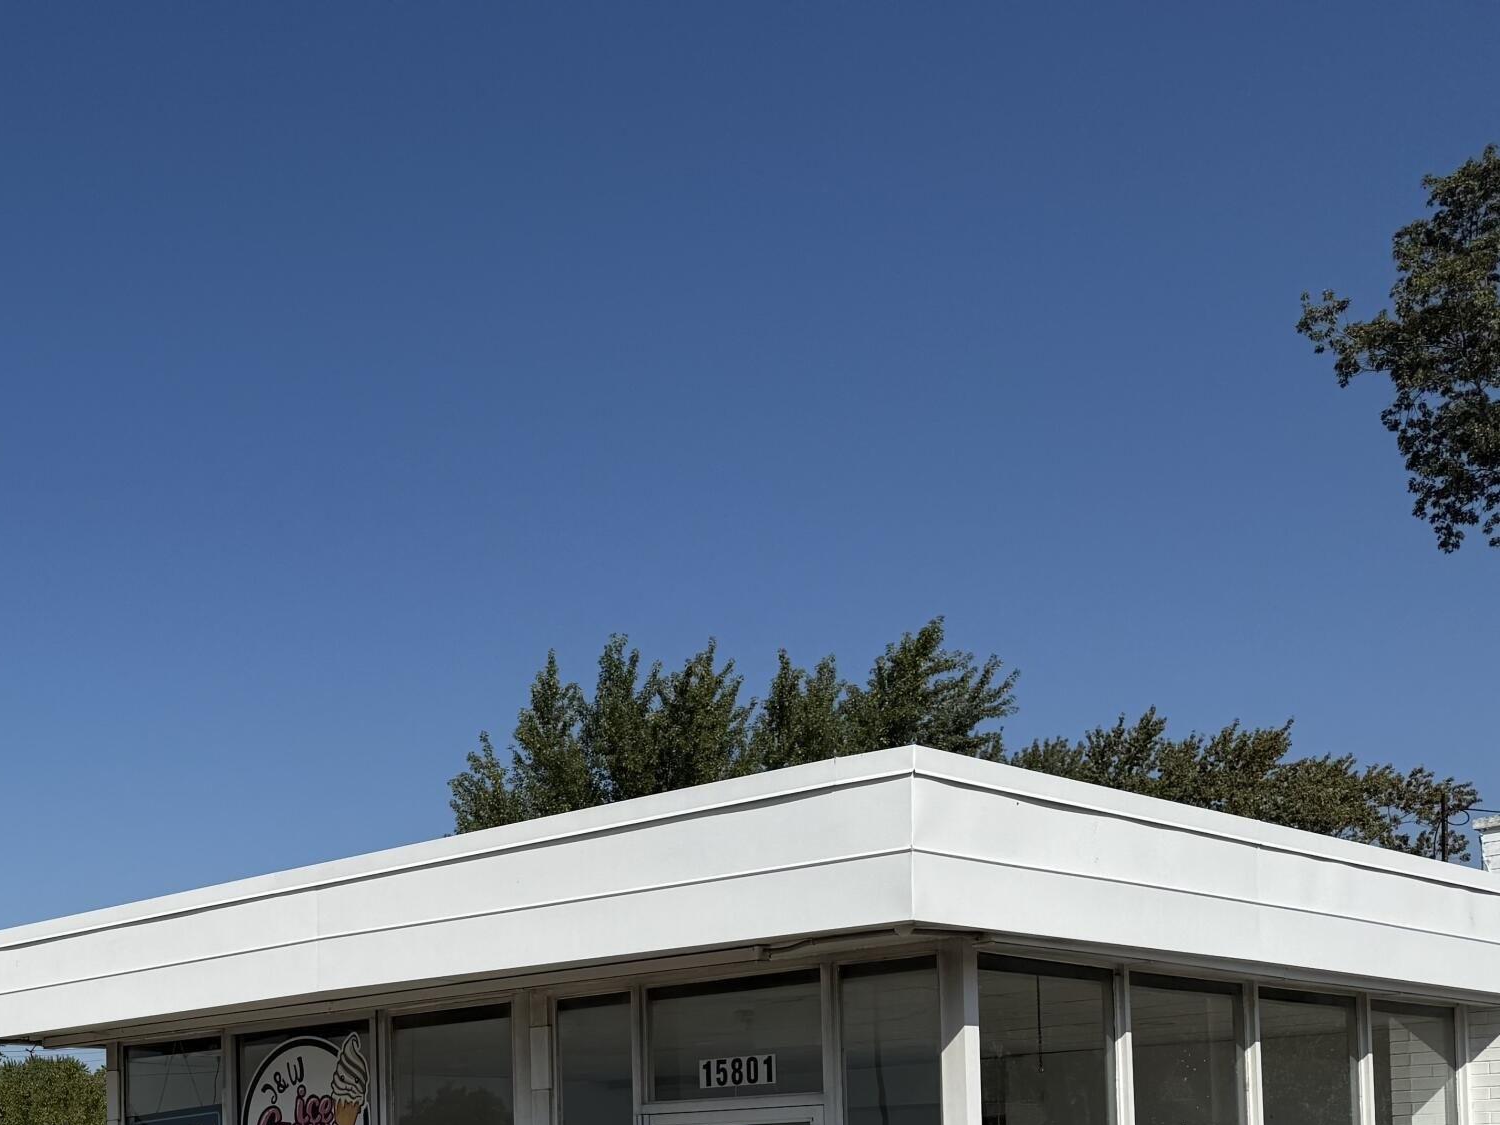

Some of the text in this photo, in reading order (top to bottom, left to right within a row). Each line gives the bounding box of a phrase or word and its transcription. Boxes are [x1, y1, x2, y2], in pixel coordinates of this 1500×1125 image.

[261, 1056, 304, 1104] J&W
[702, 1055, 773, 1087] 15801
[294, 1084, 334, 1125] ice
